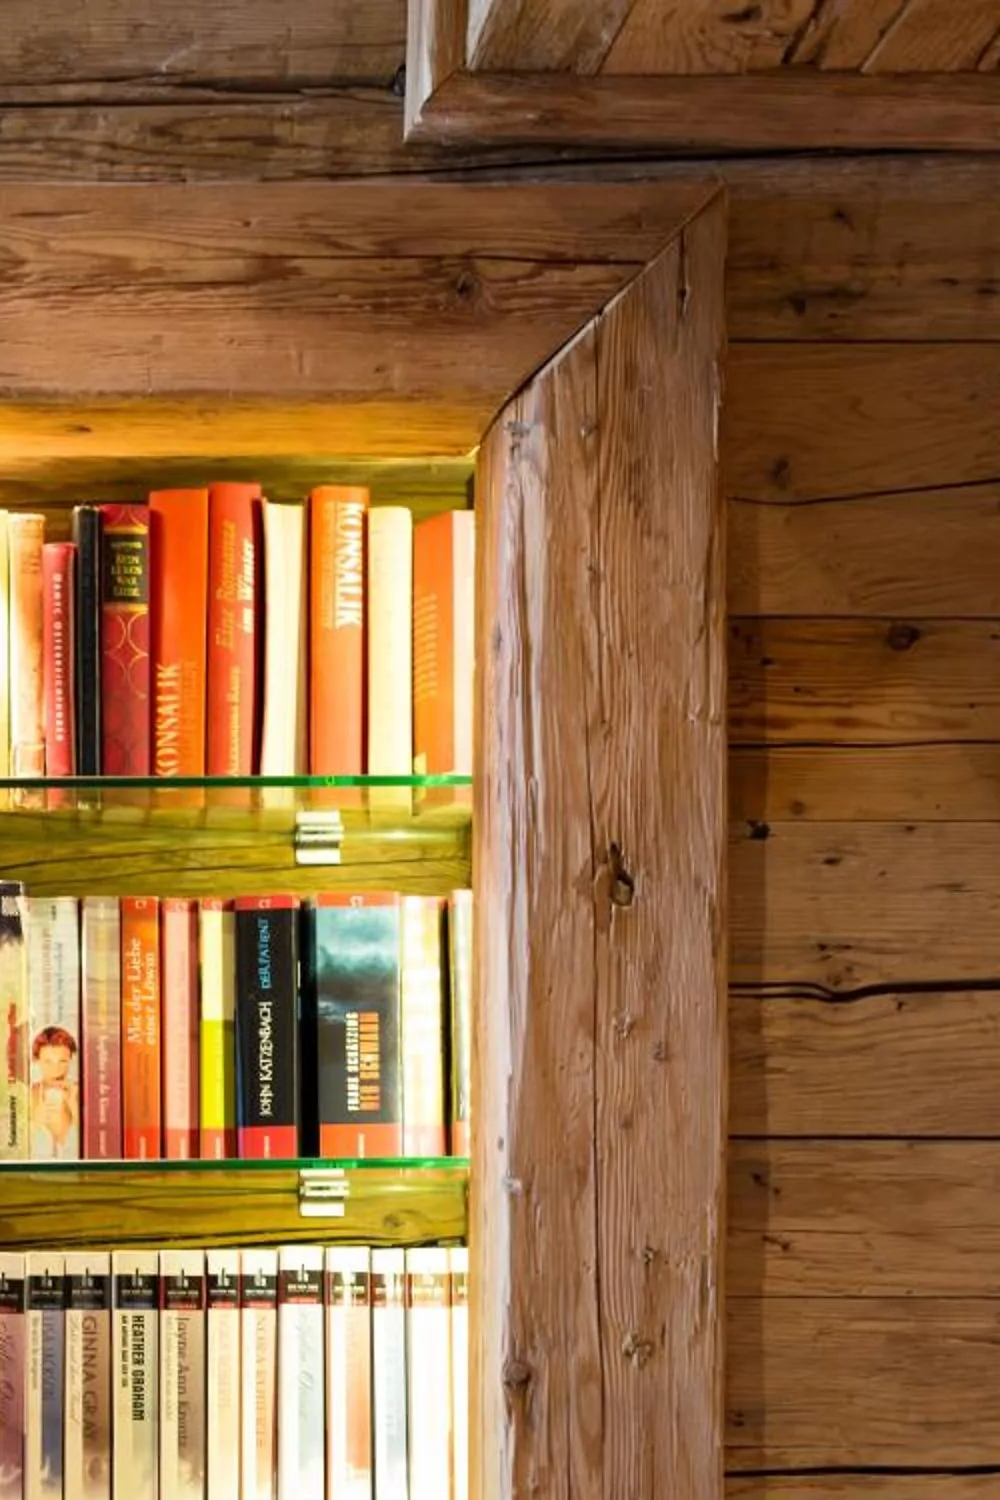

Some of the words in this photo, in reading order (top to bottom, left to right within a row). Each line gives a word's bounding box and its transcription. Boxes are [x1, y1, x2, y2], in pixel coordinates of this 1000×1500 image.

[236, 537, 254, 601] Winter
[335, 502, 364, 629] KONSALIK
[258, 1001, 273, 1082] KATZENBACH
[259, 1084, 273, 1116] JOHN
[82, 1317, 97, 1383] GINNA
[131, 1315, 145, 1366] HEATHER
[82, 1390, 97, 1441] GRAY
[132, 1370, 145, 1421] GRAHAM
